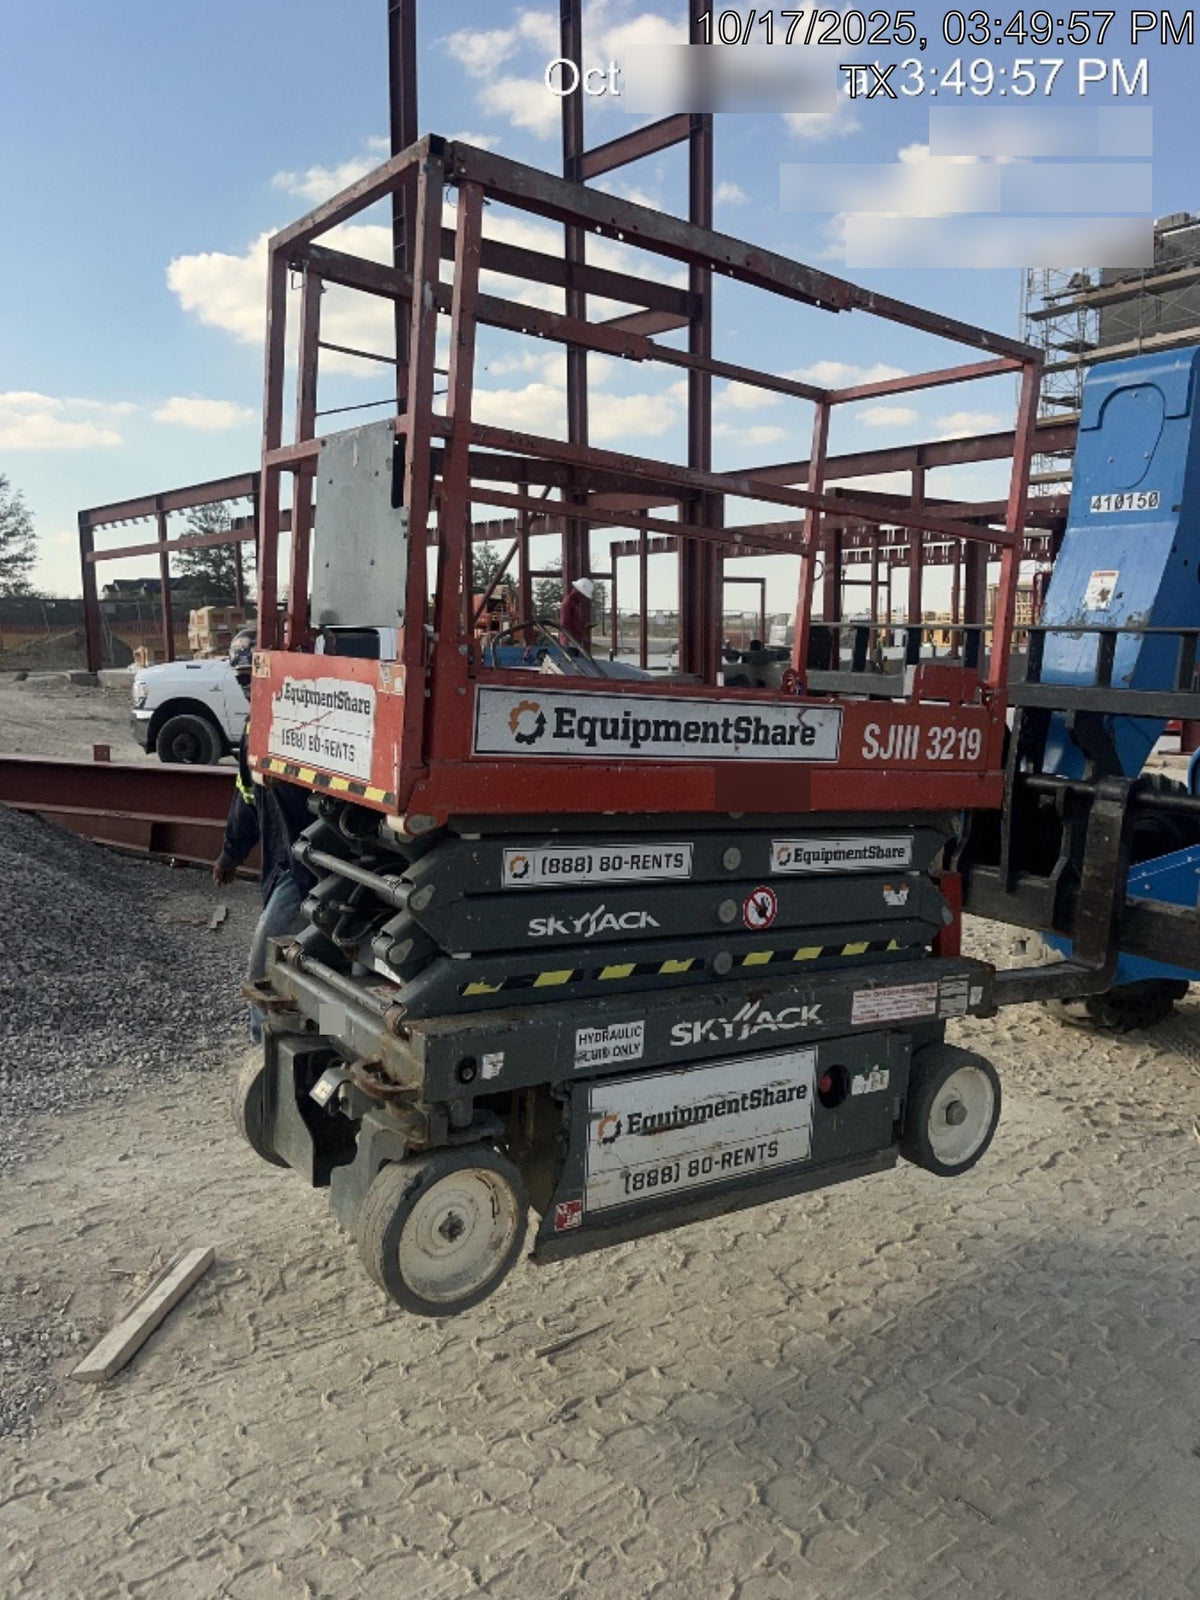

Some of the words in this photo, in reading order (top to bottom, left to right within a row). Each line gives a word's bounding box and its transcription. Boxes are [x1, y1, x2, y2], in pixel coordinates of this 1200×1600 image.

[1091, 492, 1159, 511] 410150
[284, 682, 371, 715] EquipmentShare
[552, 706, 816, 750] EquipmentShare
[925, 725, 982, 761] 3219
[540, 855, 594, 876] (888)
[599, 852, 685, 873] 80-RENTS
[792, 844, 906, 866] EquipmentShare
[528, 904, 660, 937] SKYJACK
[578, 1025, 643, 1046] HYDRAULIC
[669, 1000, 823, 1047] SKYJACK
[612, 1042, 641, 1057] ONLY
[627, 1084, 808, 1136] EquipmentShare
[624, 1164, 681, 1194] (888)
[687, 1140, 780, 1177] 80-RENTS
